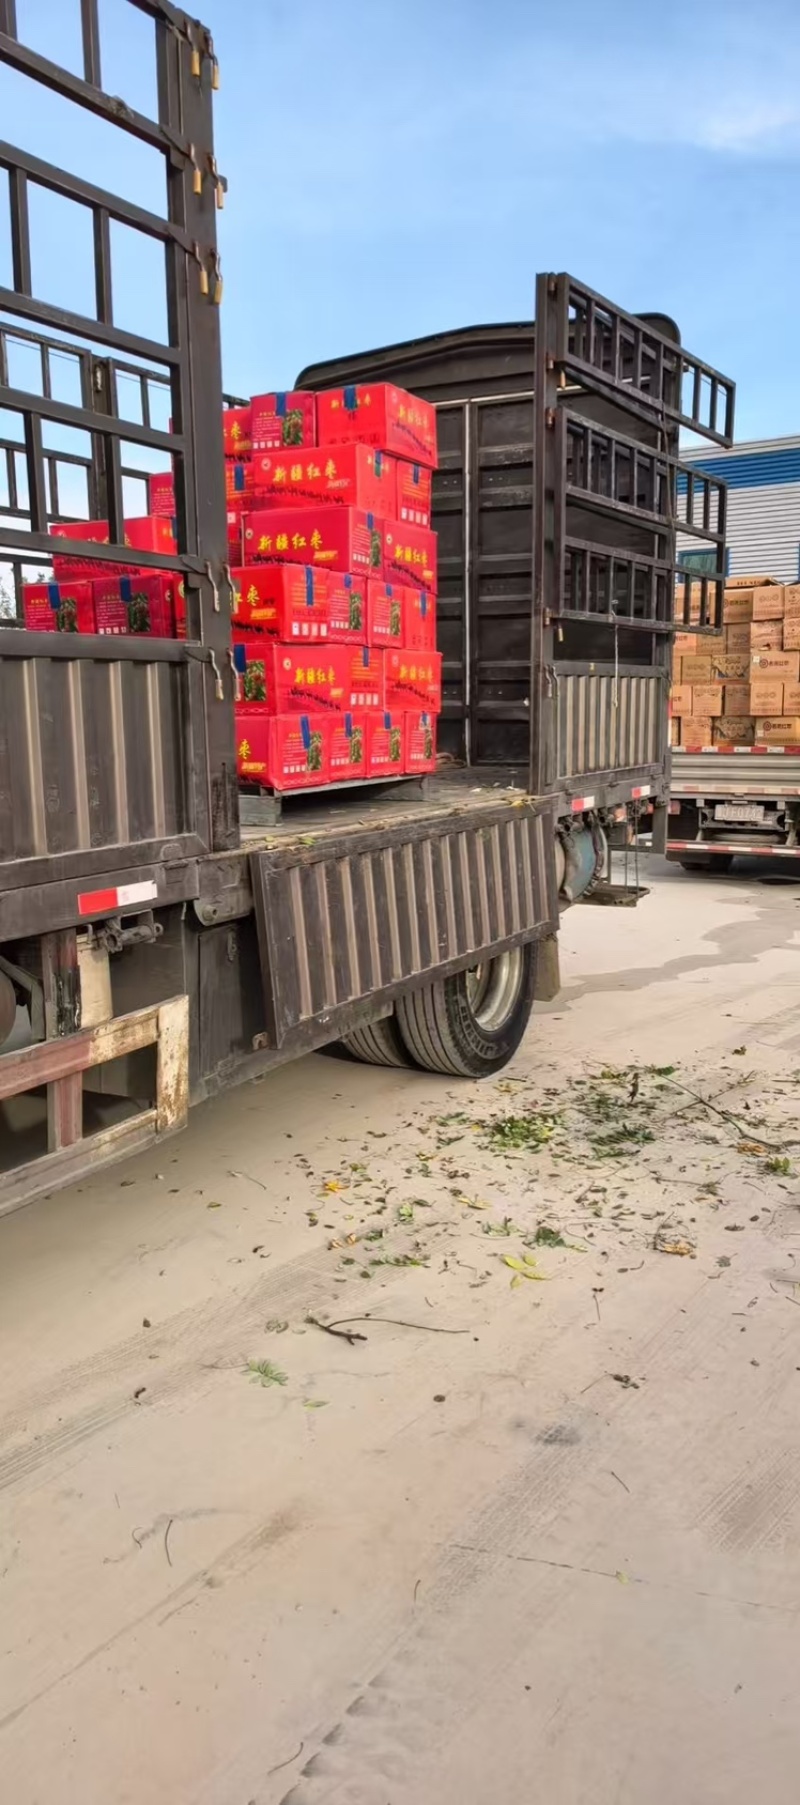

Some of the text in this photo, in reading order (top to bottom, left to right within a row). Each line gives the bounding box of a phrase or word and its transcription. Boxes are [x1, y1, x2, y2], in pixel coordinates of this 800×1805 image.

[258, 528, 323, 552] 新疆红枣
[294, 665, 335, 687] 新疆红枣
[238, 738, 251, 760] 枣
